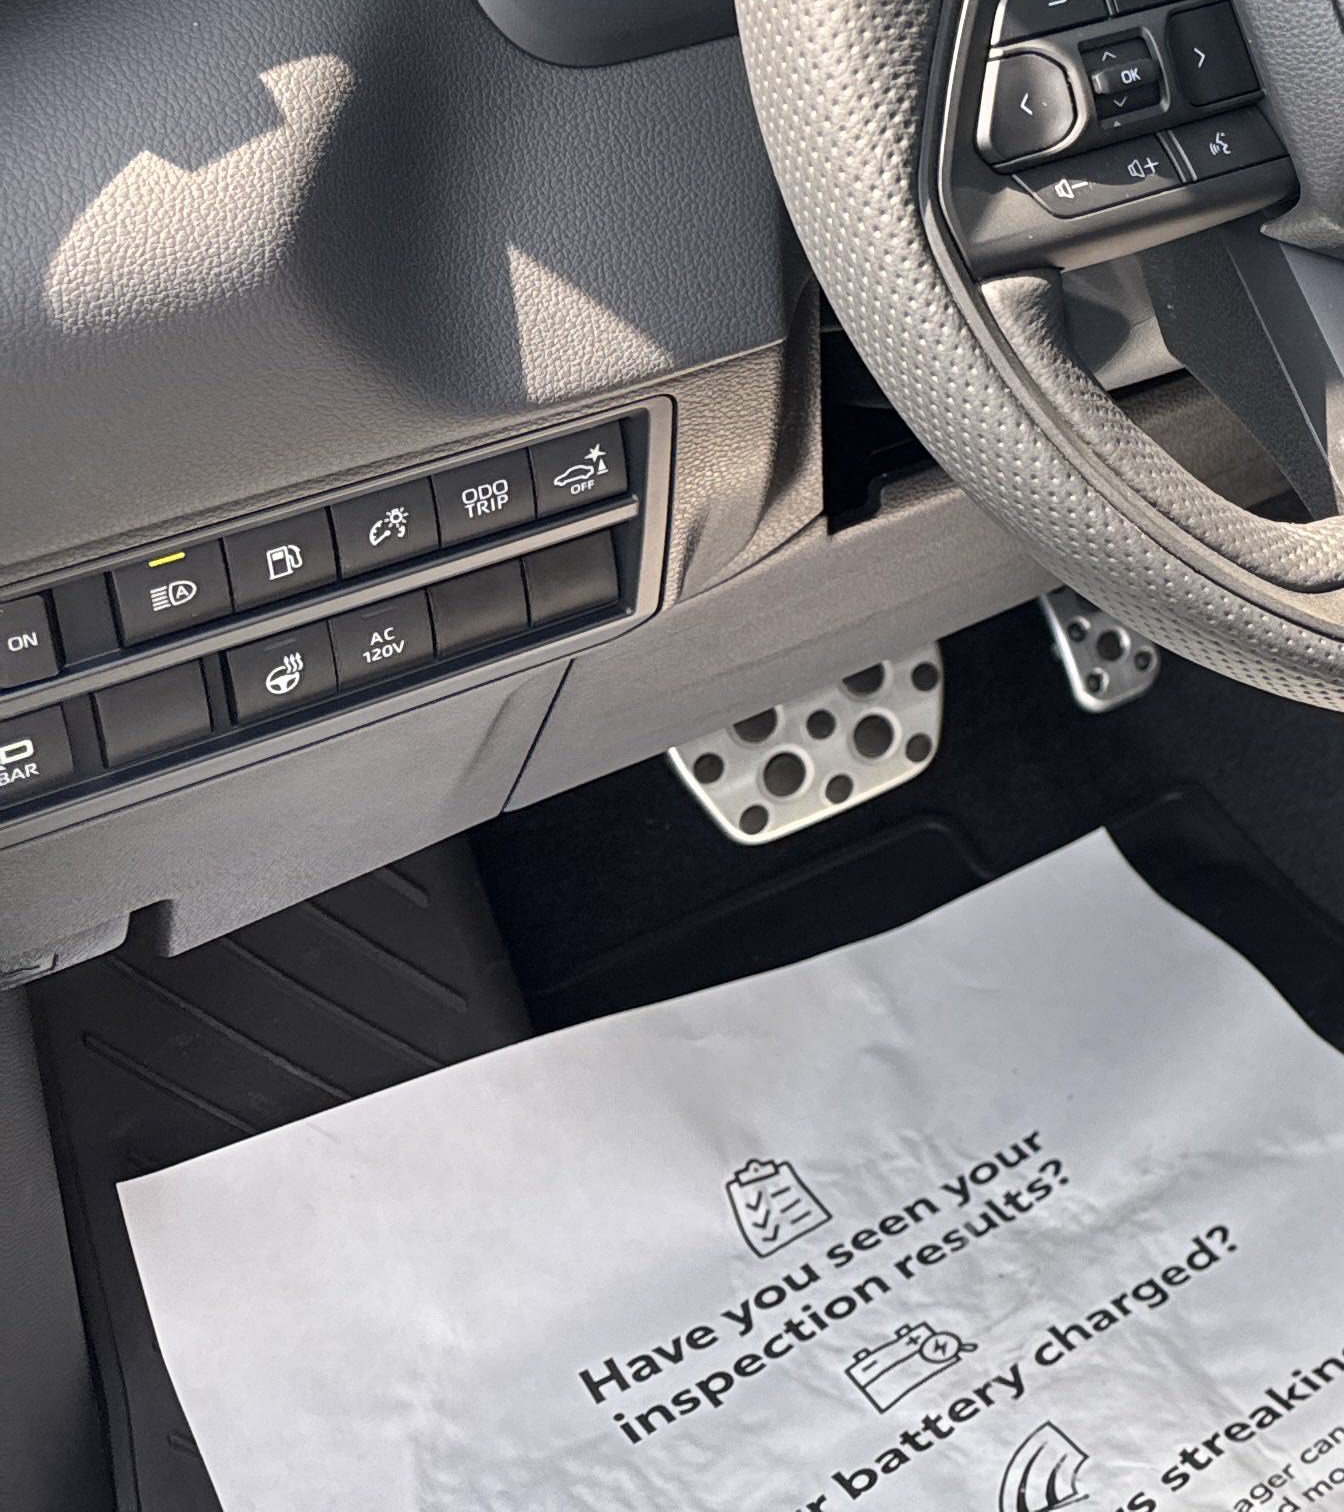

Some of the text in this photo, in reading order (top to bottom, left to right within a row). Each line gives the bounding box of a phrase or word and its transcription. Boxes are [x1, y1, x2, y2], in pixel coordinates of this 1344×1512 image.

[1120, 67, 1142, 84] OK
[461, 479, 509, 505] ODO
[570, 479, 596, 495] OFF
[464, 494, 510, 519] TRIP
[7, 632, 39, 652] ON
[369, 627, 396, 646] AC
[362, 639, 406, 664] 120V
[577, 1129, 1044, 1406] Have you seen your
[612, 1158, 1071, 1446] inspection results?
[832, 1223, 1239, 1501] battery charged?
